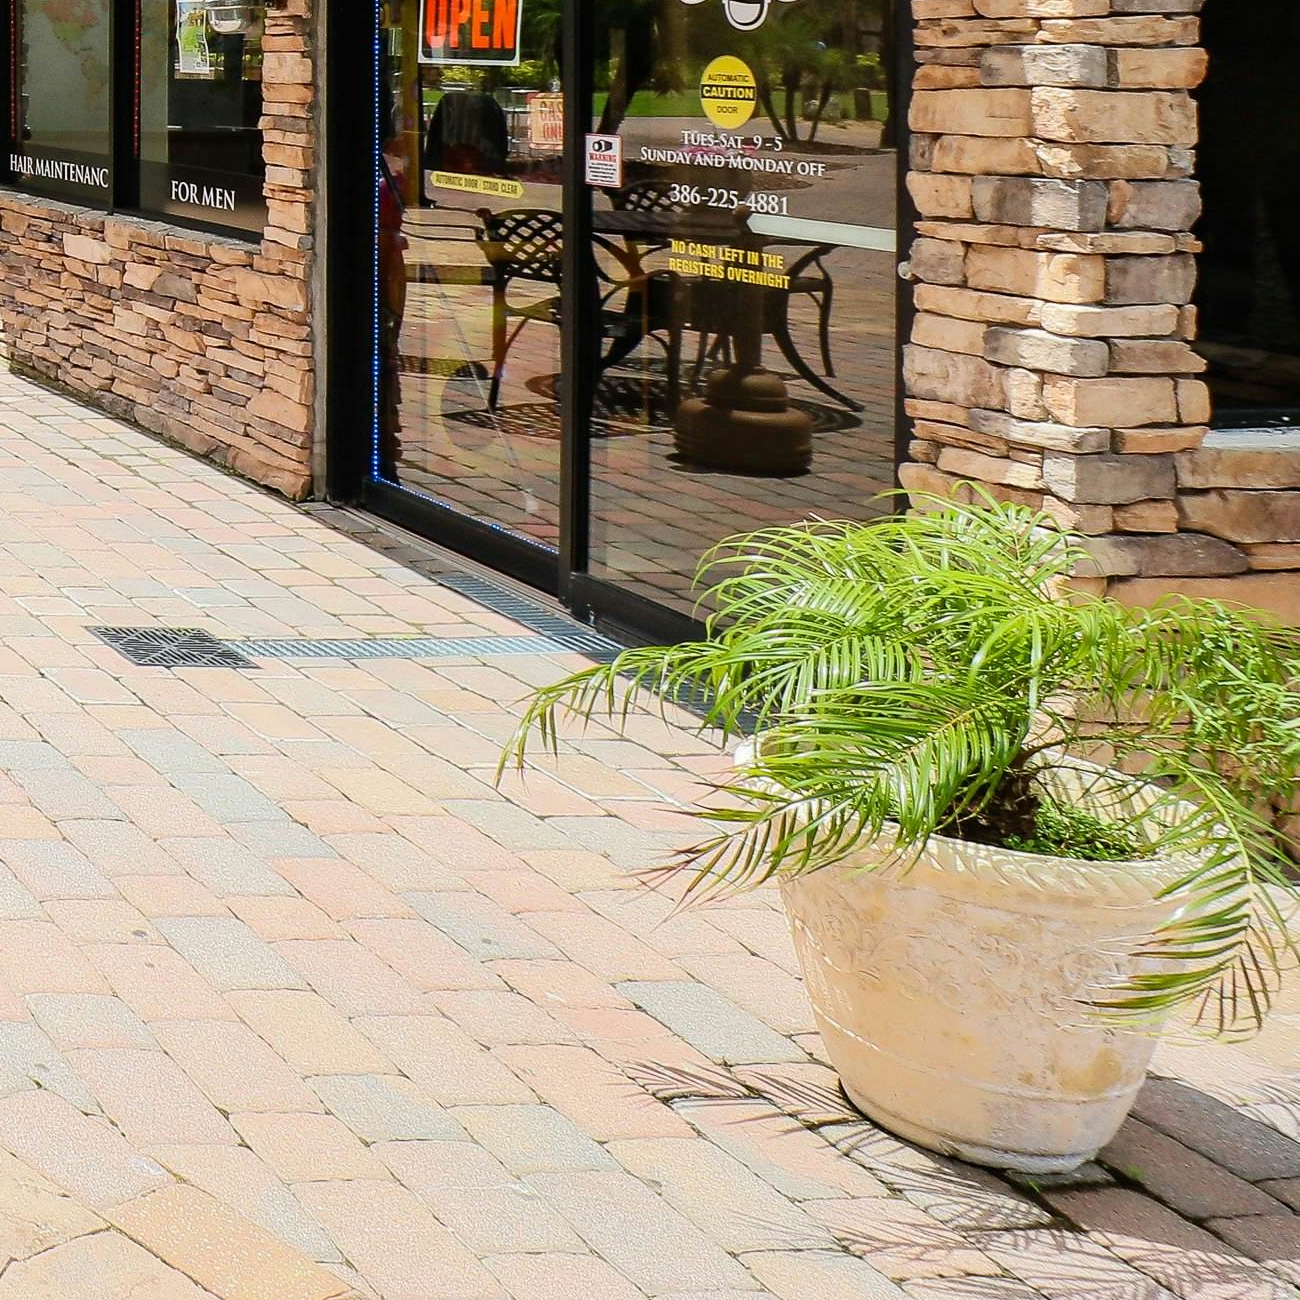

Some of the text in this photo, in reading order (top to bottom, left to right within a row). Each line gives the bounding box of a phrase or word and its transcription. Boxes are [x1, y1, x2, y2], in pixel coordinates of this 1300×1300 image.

[707, 73, 750, 83] AUTOMATIC
[702, 86, 754, 99] CAUTION
[540, 100, 563, 121] CAS
[716, 105, 738, 114] DOOR
[681, 130, 745, 149] TUES-SAT
[10, 153, 109, 189] HAIR MAINTENANC
[640, 146, 827, 177] SUNDAY AND MONDAY OFF
[171, 179, 236, 211] FOR MEN
[500, 183, 518, 194] CLEAR
[670, 183, 789, 215] 386-225-4881
[671, 239, 784, 270] NO CASH LEFT IN THE
[668, 257, 791, 290] REGISTERS OVERNIGHT
